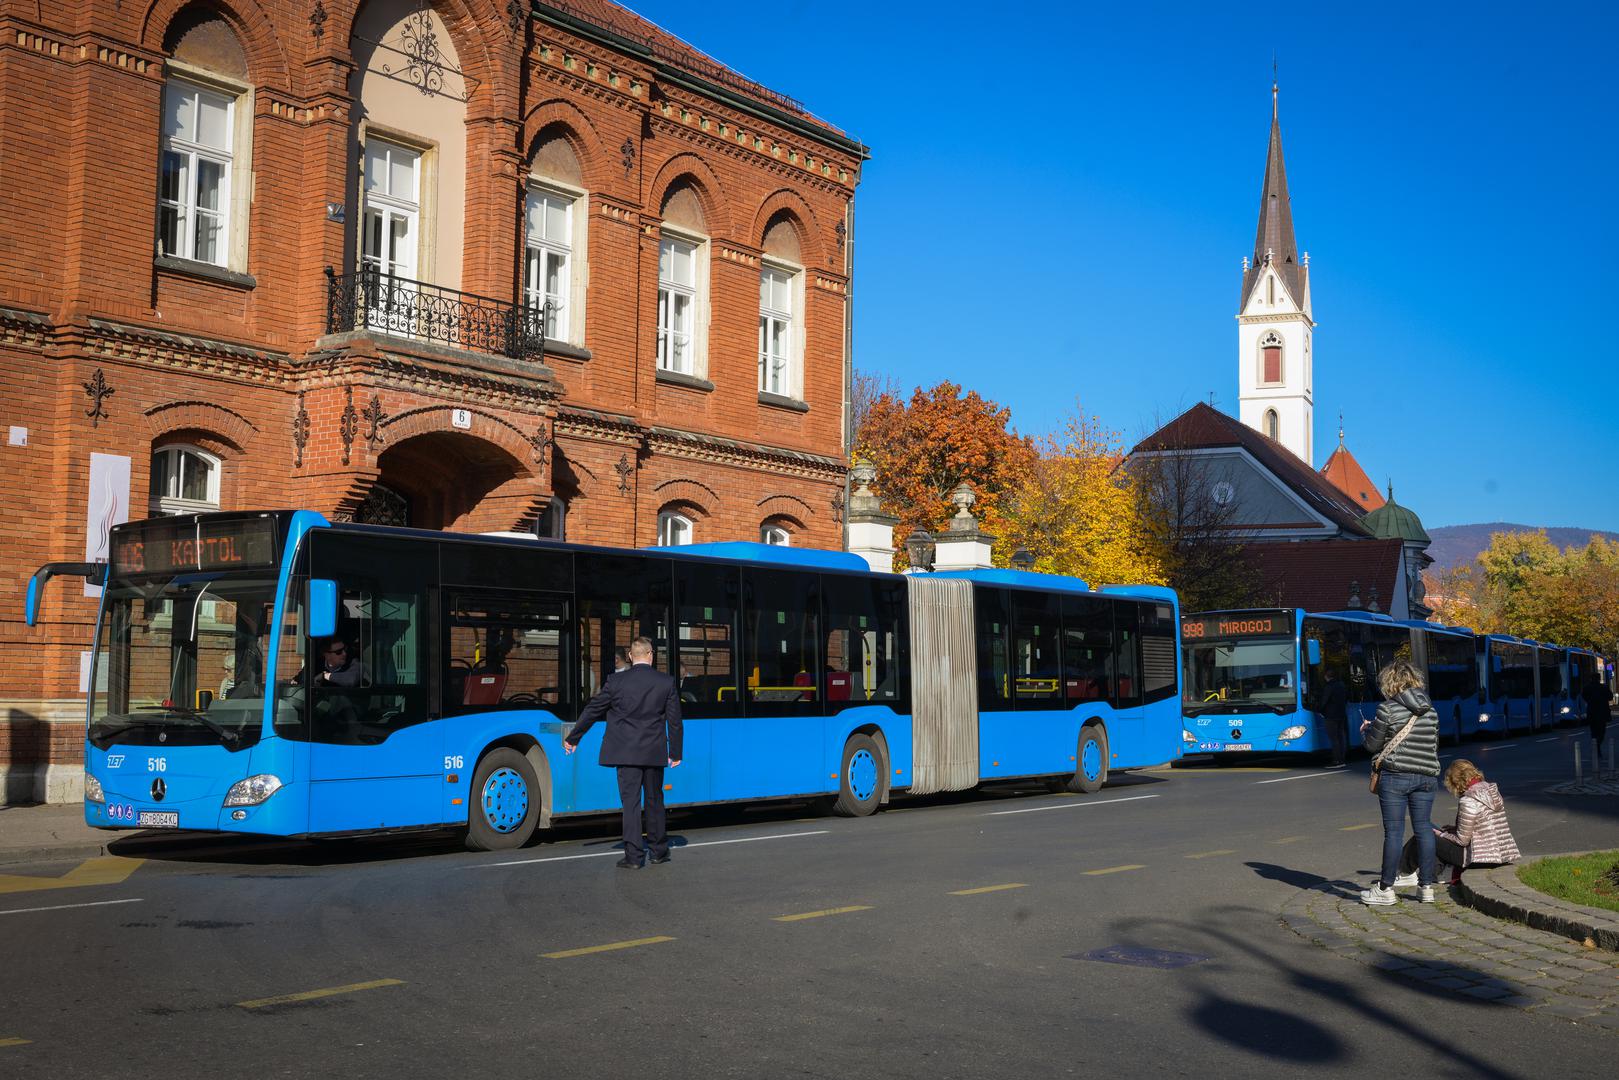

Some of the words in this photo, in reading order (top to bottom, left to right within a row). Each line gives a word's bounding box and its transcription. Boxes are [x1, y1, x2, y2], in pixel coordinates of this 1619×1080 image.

[459, 410, 465, 423] 6
[172, 537, 242, 566] KAPTOL
[1183, 622, 1204, 638] 998
[1219, 619, 1272, 635] MIROGOJ
[148, 757, 167, 772] 516
[444, 755, 464, 769] 516
